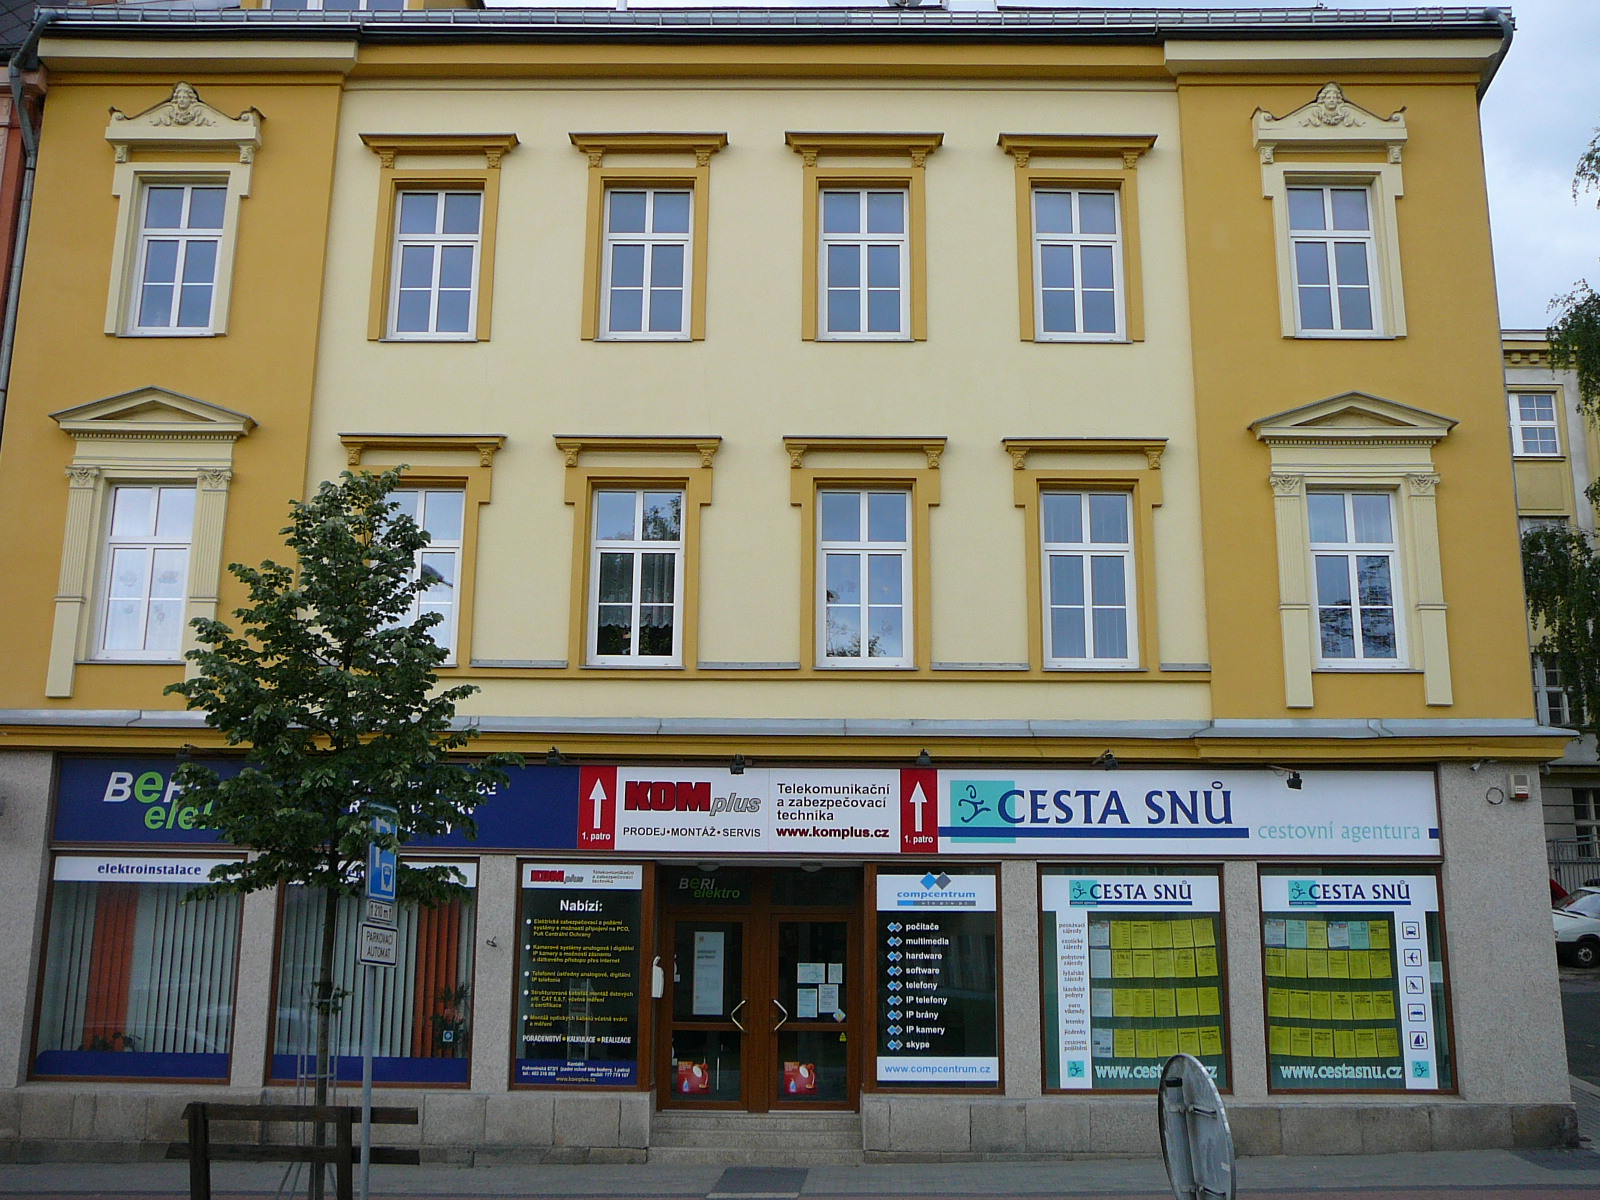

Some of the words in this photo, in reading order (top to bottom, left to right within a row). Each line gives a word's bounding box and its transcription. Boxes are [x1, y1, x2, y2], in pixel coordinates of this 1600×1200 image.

[777, 783, 890, 795] Telekomunikační
[776, 799, 784, 807] a
[788, 796, 886, 810] zabezpečovací
[998, 789, 1130, 825] CESTA
[1145, 780, 1233, 825] SNŮ
[777, 810, 834, 821] technika
[582, 832, 589, 840] 1.
[590, 833, 611, 842] patro
[623, 827, 666, 836] PRODEJ
[671, 826, 716, 837] MONTÁŽ
[722, 828, 761, 838] SERVIS
[776, 826, 890, 840] www.komplus.cz
[1258, 821, 1334, 840] cestovní
[1341, 822, 1421, 843] agentura
[904, 835, 912, 844] 1.
[913, 835, 934, 845] patro
[97, 864, 202, 876] elektroinstalace
[678, 877, 715, 890] BeRI
[694, 886, 740, 898] elektro
[897, 890, 976, 899] compcentrum
[1090, 884, 1148, 900] CESTA
[1154, 880, 1192, 900] SNŮ
[1308, 884, 1366, 900] CESTA
[1372, 880, 1410, 900] SNŮ
[560, 900, 603, 912] Nabízí:
[906, 922, 939, 932] počítače
[906, 938, 950, 946] multimedia
[367, 946, 391, 959] AUTOMAT
[906, 952, 942, 960] hardware
[906, 966, 940, 974] software
[906, 981, 938, 990] telefony
[906, 996, 914, 1004] IP
[916, 996, 948, 1006] telefony
[916, 1010, 938, 1020] brány
[916, 1026, 946, 1035] kamery
[522, 1034, 562, 1042] PORADENSTVÍ
[601, 1036, 632, 1044] REALIZACE
[906, 1040, 930, 1050] skype
[885, 1065, 991, 1074] www.compcentrum.cz
[1280, 1063, 1403, 1079] www.cestasnu.cz
